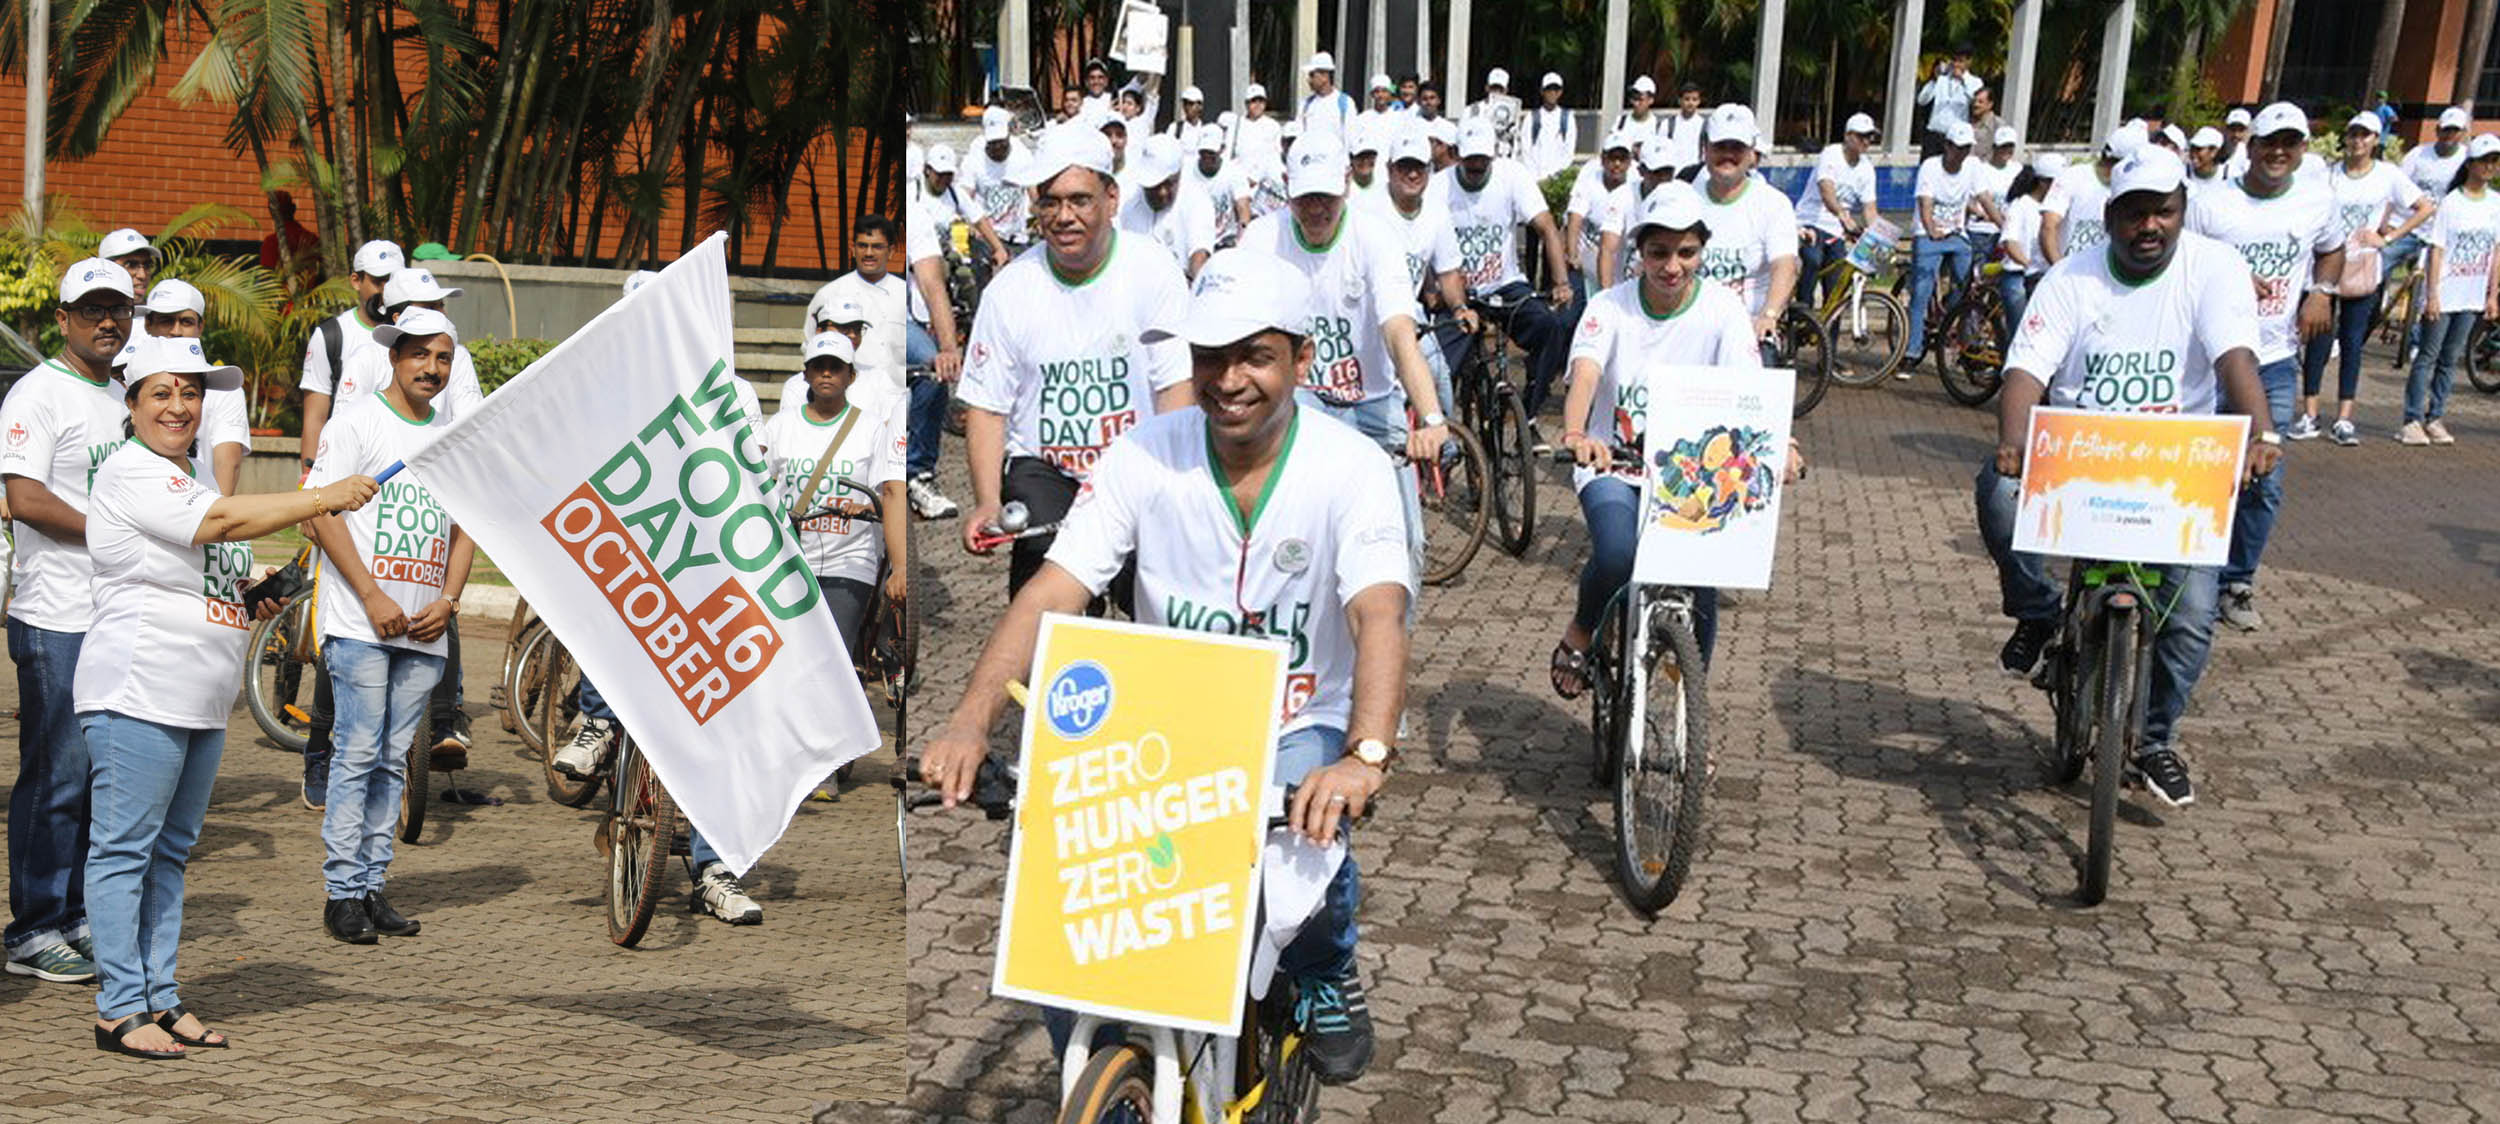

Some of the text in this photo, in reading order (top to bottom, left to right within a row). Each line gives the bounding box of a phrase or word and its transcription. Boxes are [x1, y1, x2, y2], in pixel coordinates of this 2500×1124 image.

[1040, 356, 1128, 386] WORLD
[2086, 350, 2175, 375] WORLD
[1040, 382, 1130, 416] FOOD
[2076, 375, 2174, 406] FOOD
[1039, 418, 1094, 447] DAY
[786, 458, 854, 476] WOLD
[637, 394, 820, 620] FOOD
[801, 515, 850, 535] TOBER
[374, 531, 428, 559] DAY
[589, 441, 720, 583] DAY
[697, 594, 774, 673] 16
[373, 559, 444, 588] OCTOBER
[554, 498, 730, 718] OCTOBER
[1051, 676, 1108, 728] Kroger
[1047, 731, 1171, 808] ZERO
[1053, 767, 1251, 860] HUNGER
[1058, 846, 1182, 915] ZERO
[1064, 882, 1234, 965] WASTE
